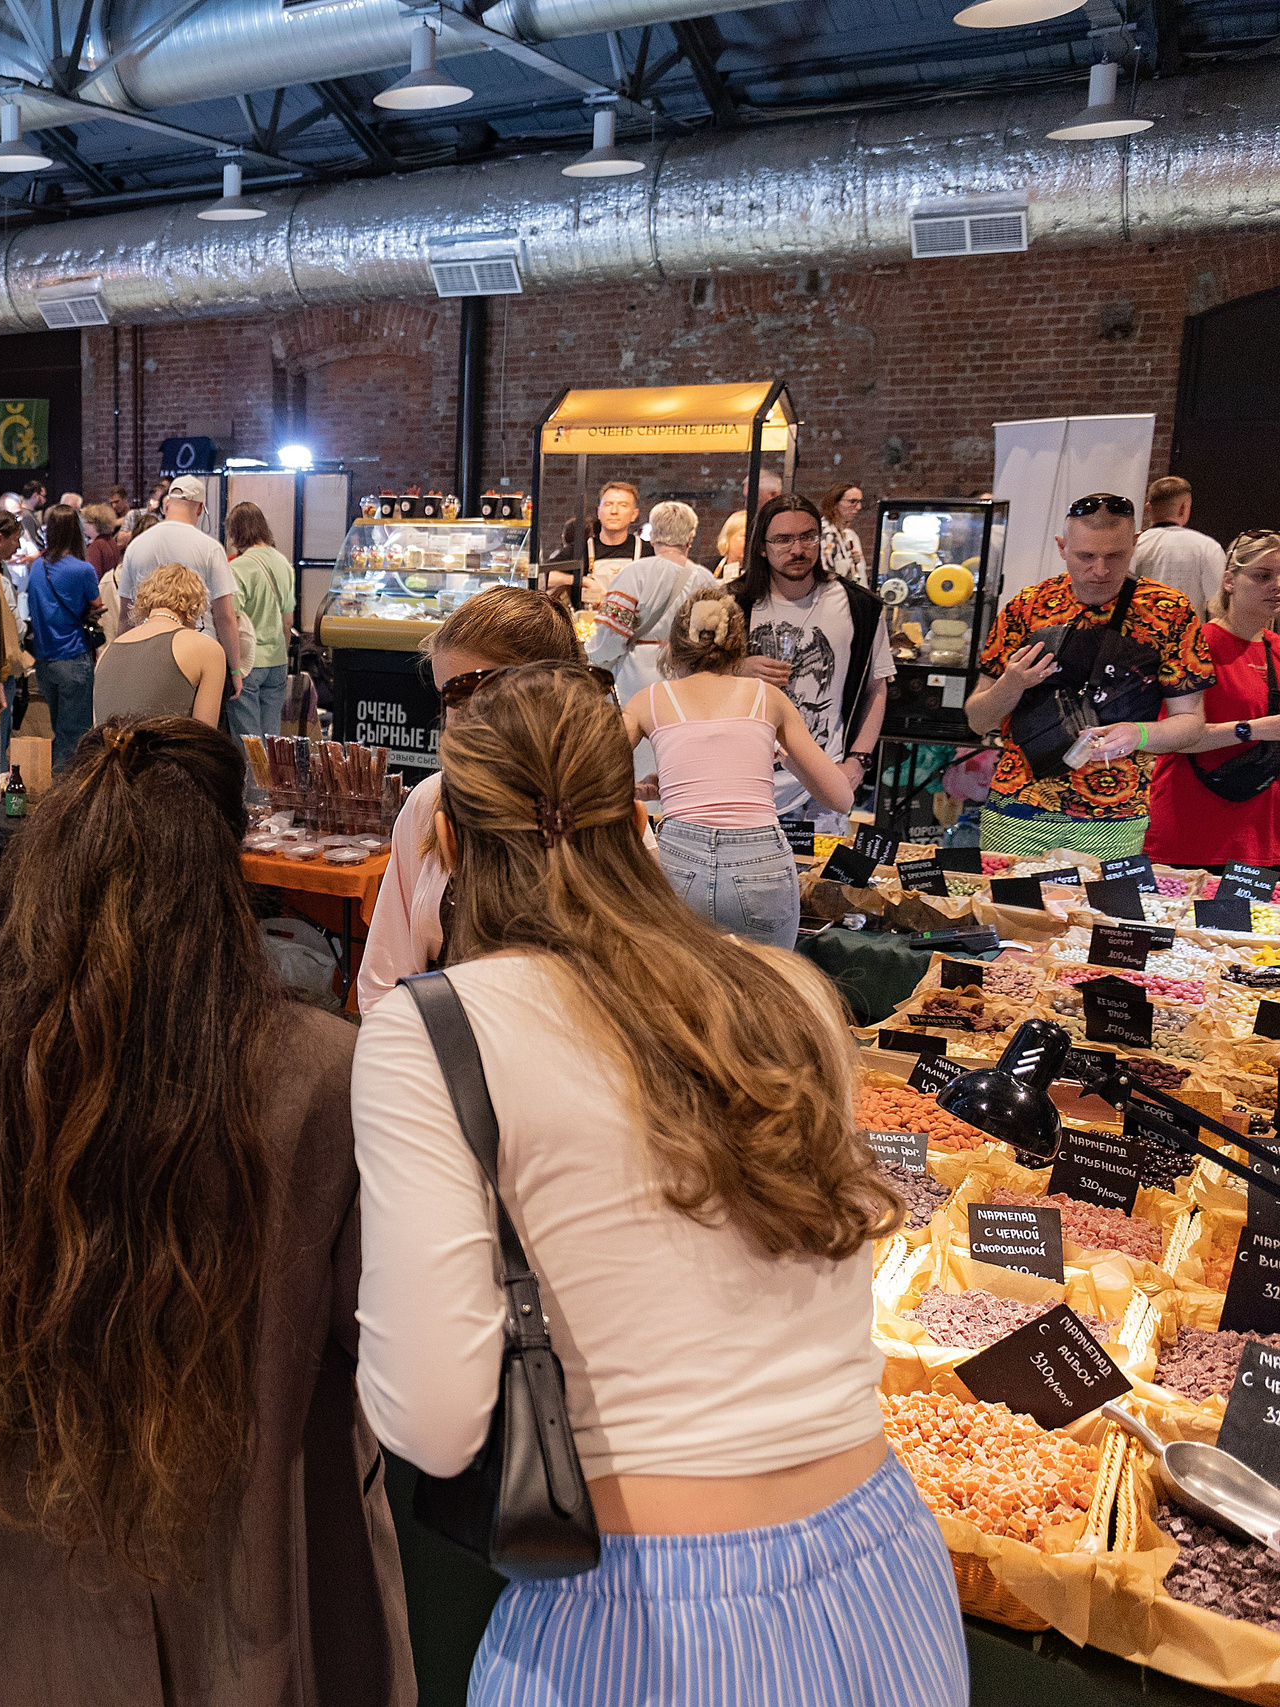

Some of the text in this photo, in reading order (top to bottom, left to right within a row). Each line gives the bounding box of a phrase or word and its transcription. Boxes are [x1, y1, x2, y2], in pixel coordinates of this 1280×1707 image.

[587, 423, 740, 438] ОЧЕНЬ СЫРНЫЕ ДЕЛА
[356, 700, 407, 724] ОЧЕНЬ
[356, 722, 425, 748] СЫРНЫЕ
[917, 1061, 950, 1083] МАЛИН
[934, 1058, 962, 1076] МИНД
[869, 1132, 916, 1145] КЛЮКВА
[1068, 1133, 1128, 1158] МАРМЕЛАД
[1058, 1150, 1139, 1179] С КЛУБНИКОЙ
[1253, 1163, 1263, 1174] С
[977, 1209, 1037, 1223] МАРМЕЛАД
[984, 1225, 1040, 1240] С ЧЕРНОЙ
[972, 1241, 1047, 1257] СМОРОДИНОЙ
[1238, 1251, 1280, 1269] С ВИ
[1038, 1323, 1101, 1388] С АЙВОЙ
[1059, 1315, 1113, 1379] МАРМЕЛАД
[1241, 1371, 1254, 1387] С
